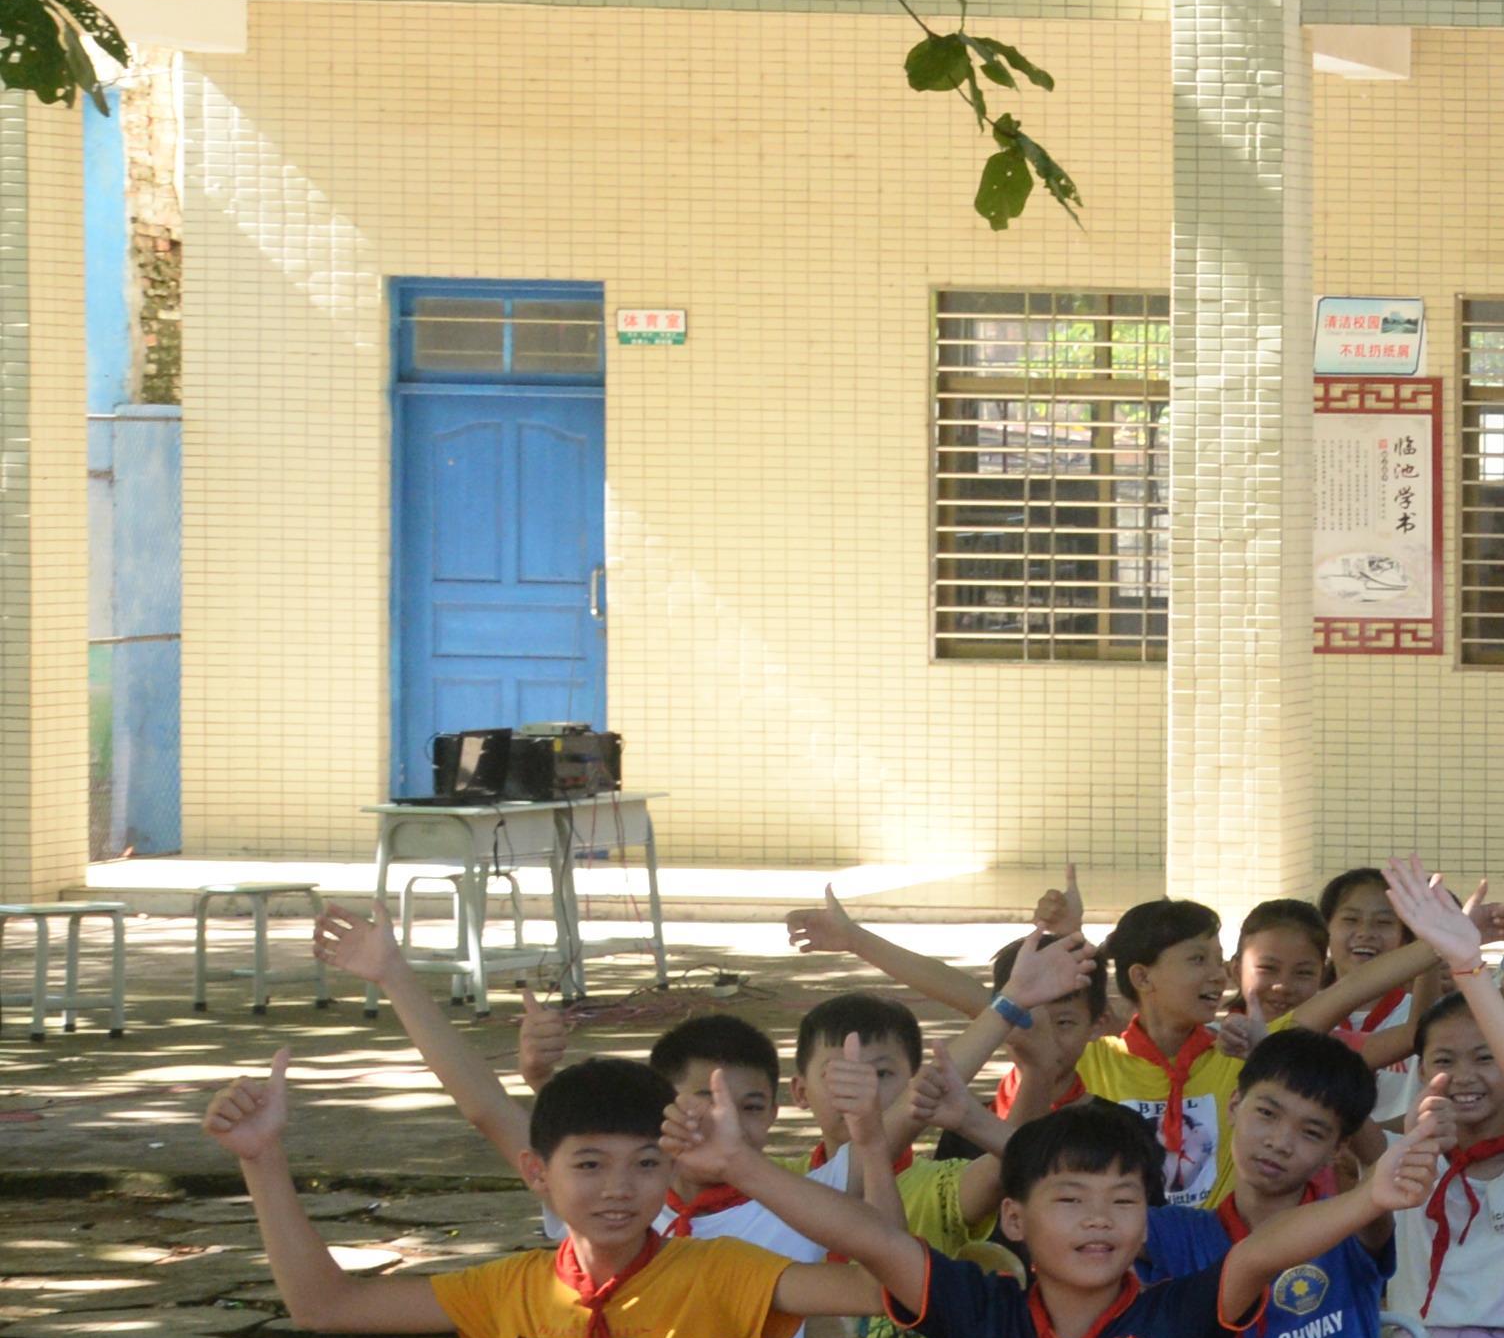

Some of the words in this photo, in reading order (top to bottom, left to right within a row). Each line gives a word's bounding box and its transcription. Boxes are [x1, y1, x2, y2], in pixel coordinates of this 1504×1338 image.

[623, 313, 681, 329] 体育室
[1324, 314, 1381, 330] 清洁校园
[1339, 343, 1410, 359] 不乱扔纸屑
[1393, 435, 1420, 534] 临池学书
[1138, 1099, 1199, 1114] BEL
